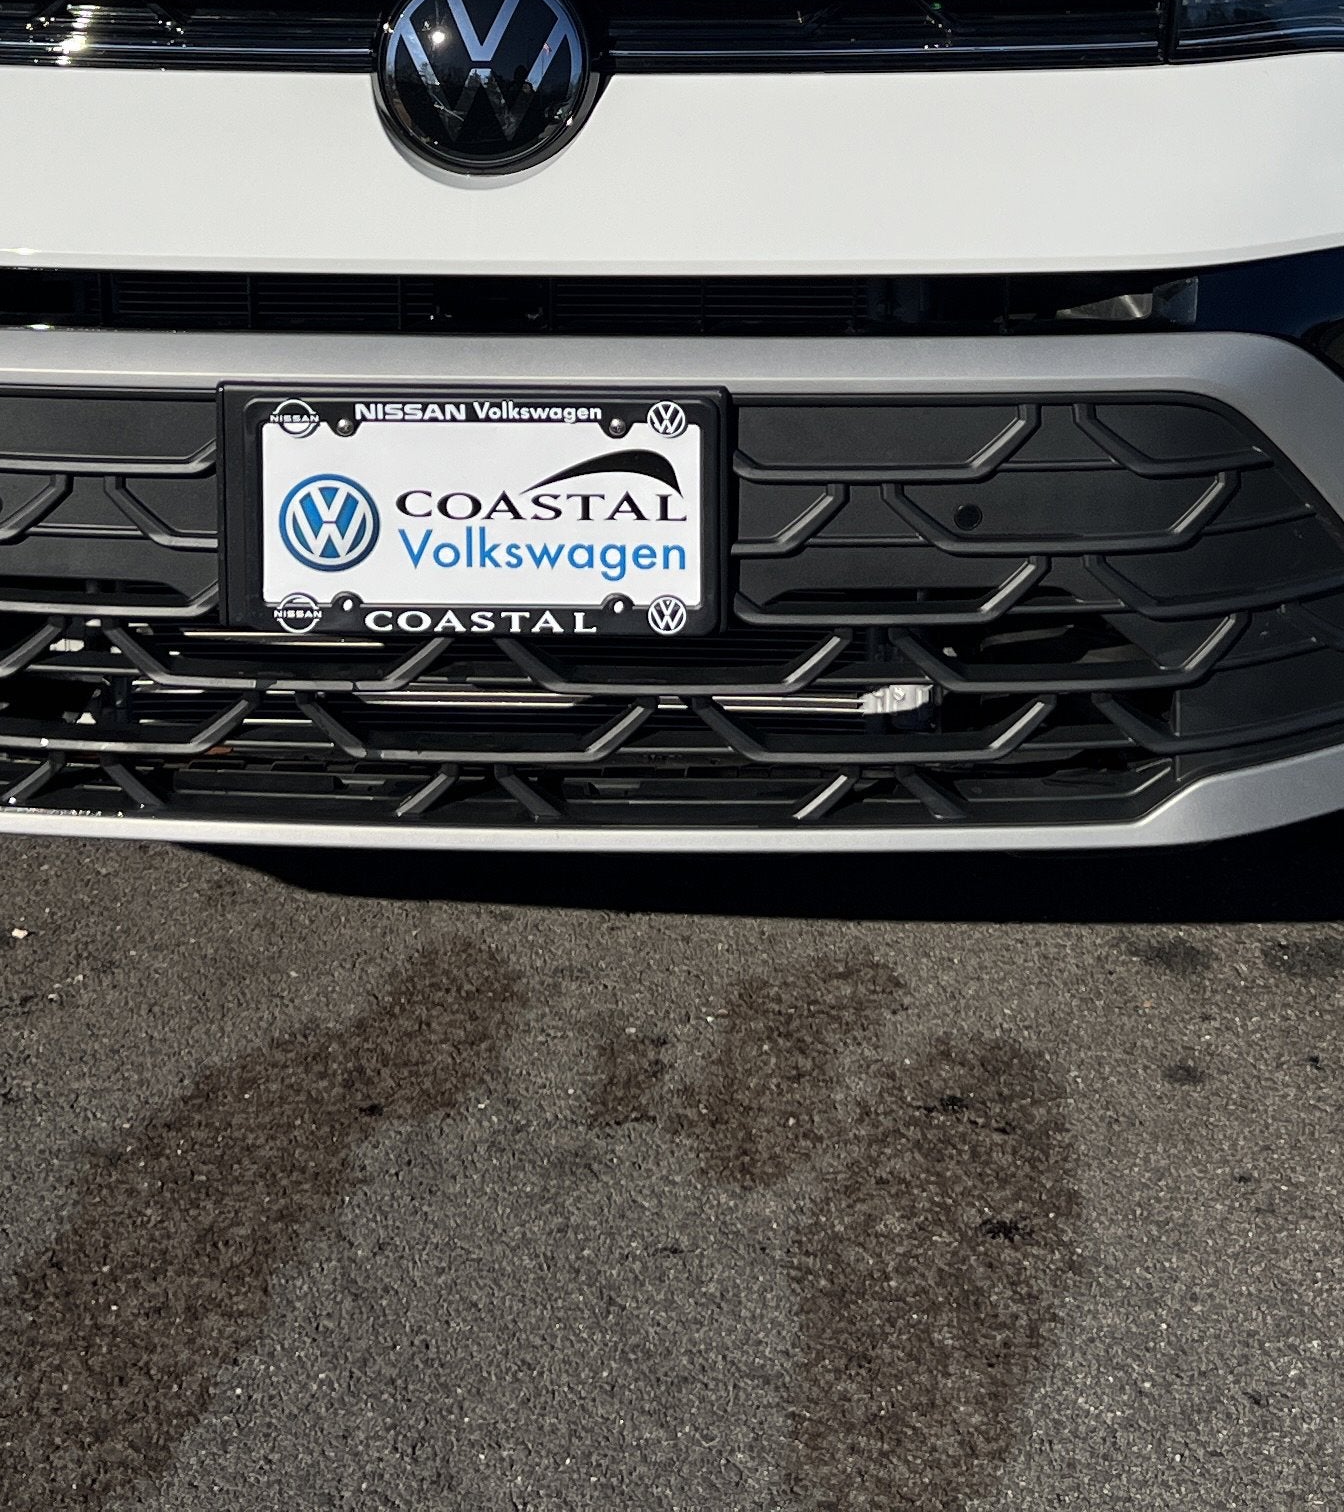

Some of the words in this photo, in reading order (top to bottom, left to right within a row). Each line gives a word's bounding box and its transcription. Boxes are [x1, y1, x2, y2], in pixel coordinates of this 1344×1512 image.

[269, 414, 320, 423] NISSAN
[354, 402, 466, 421] NISSAN
[472, 400, 602, 424] Volkswagen
[395, 489, 687, 522] COASTAL
[286, 478, 375, 566] VW
[397, 526, 686, 582] Volkswagen
[274, 610, 323, 619] NISSAN
[364, 609, 597, 633] COASTAL
